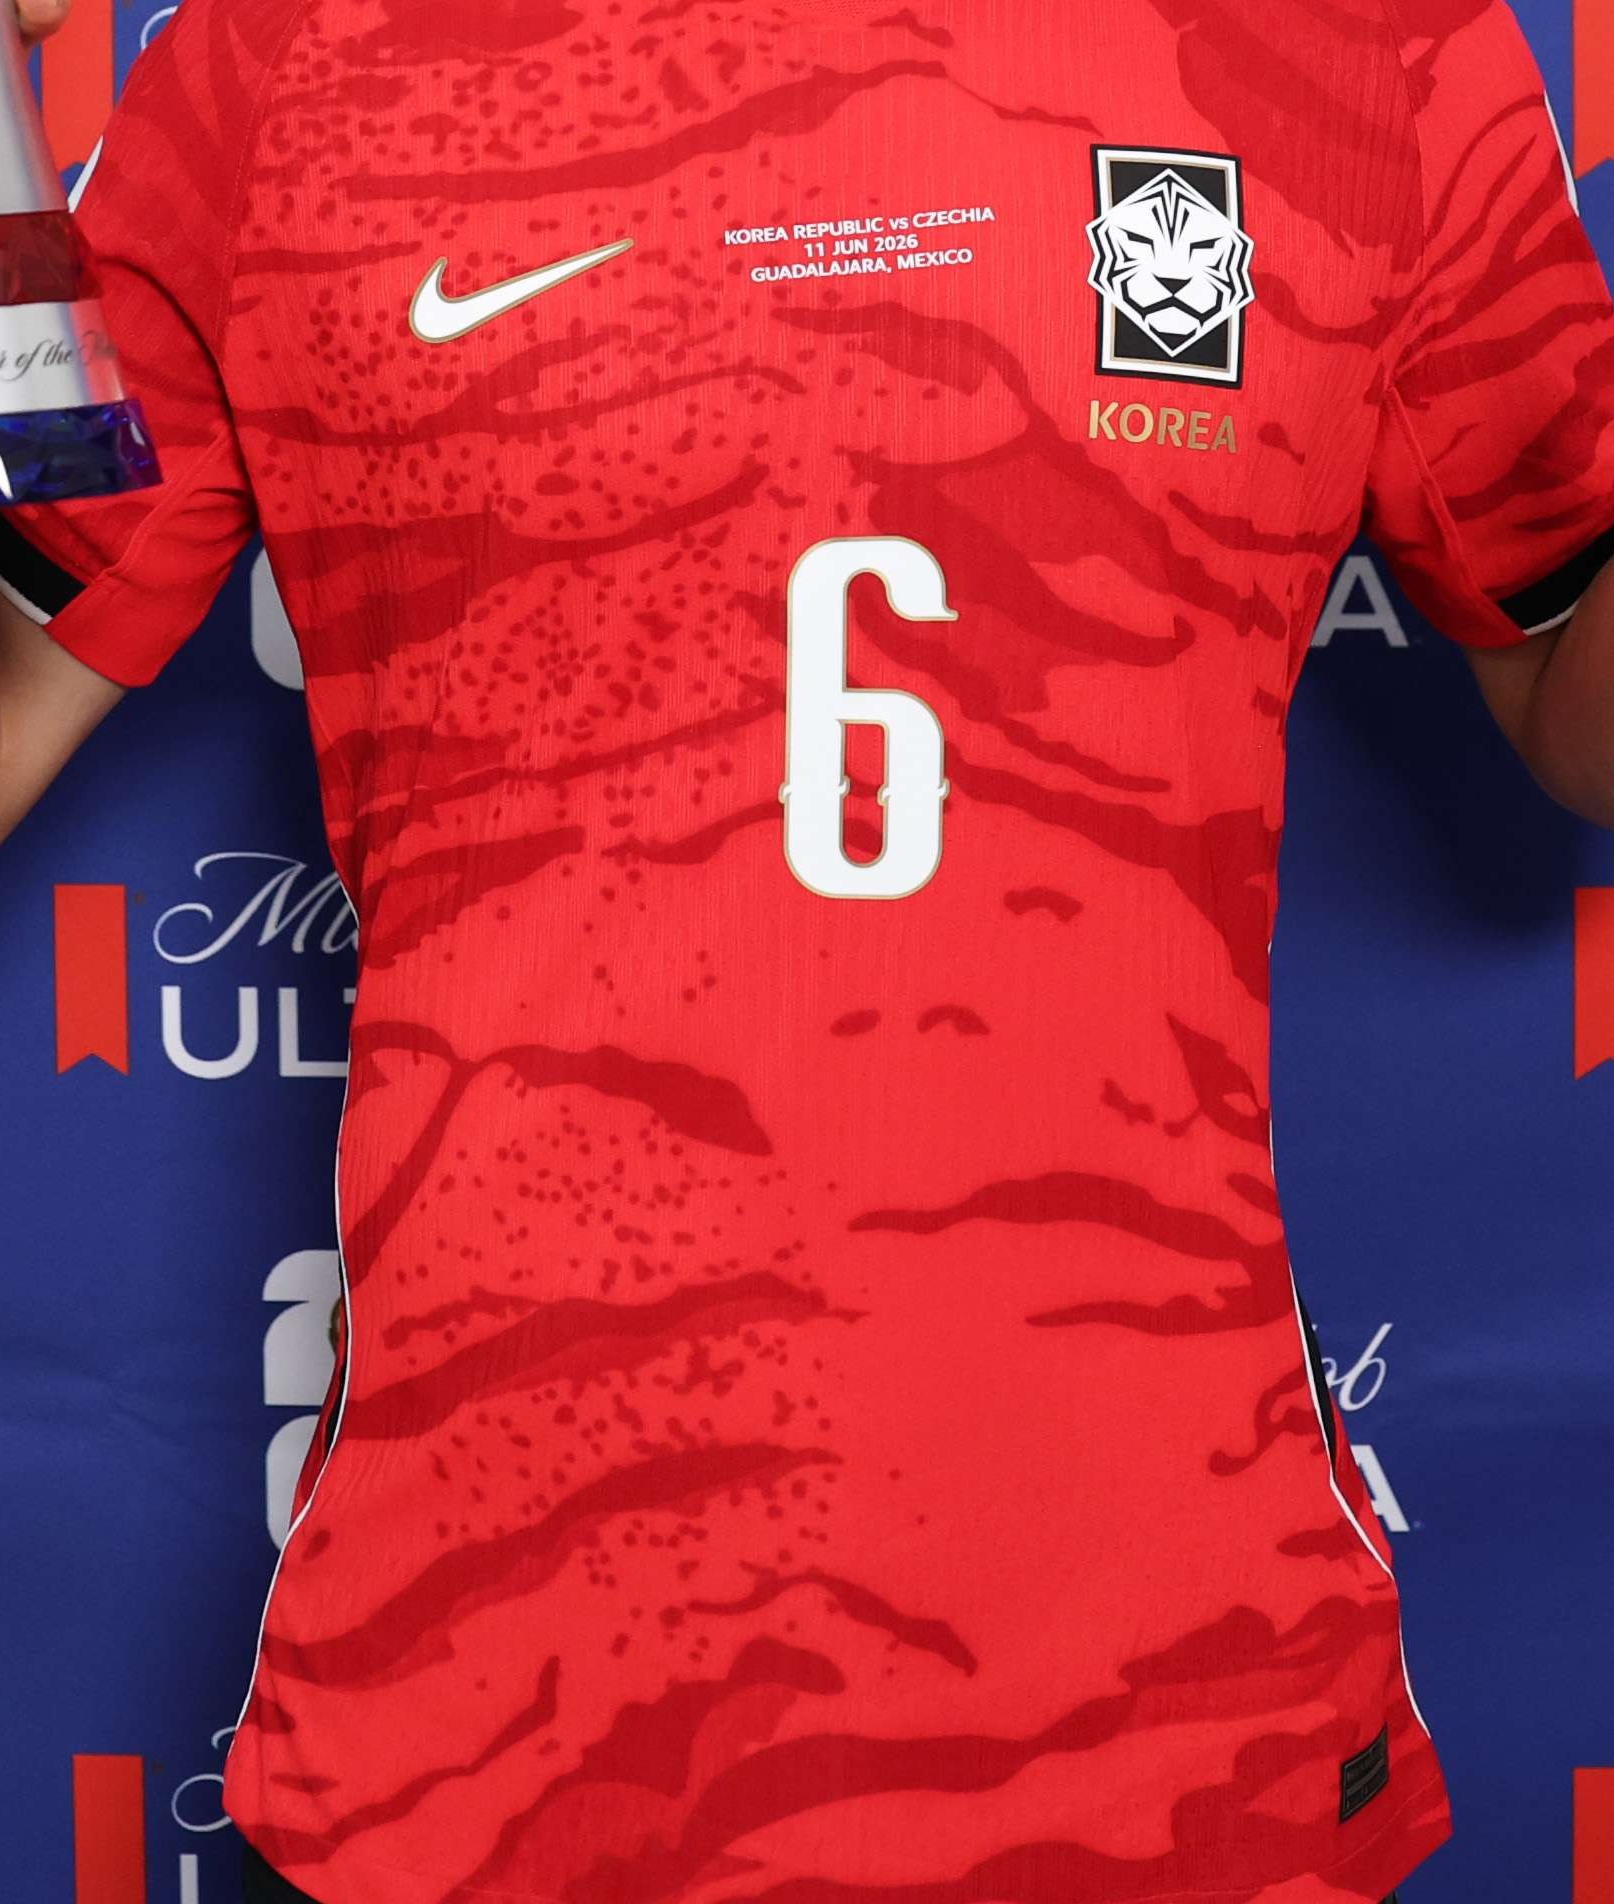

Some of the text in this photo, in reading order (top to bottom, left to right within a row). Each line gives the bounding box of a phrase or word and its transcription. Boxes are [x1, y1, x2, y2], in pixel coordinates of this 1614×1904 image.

[723, 206, 996, 246] KOREA REPUBLIC vs CZECHIA
[803, 233, 919, 258] 11 JUN 2026
[750, 248, 974, 283] GUADALAJARA, MEXICO
[1, 339, 52, 382] of
[42, 339, 75, 367] the
[1088, 399, 1237, 455] KOREA
[778, 535, 959, 900] 6
